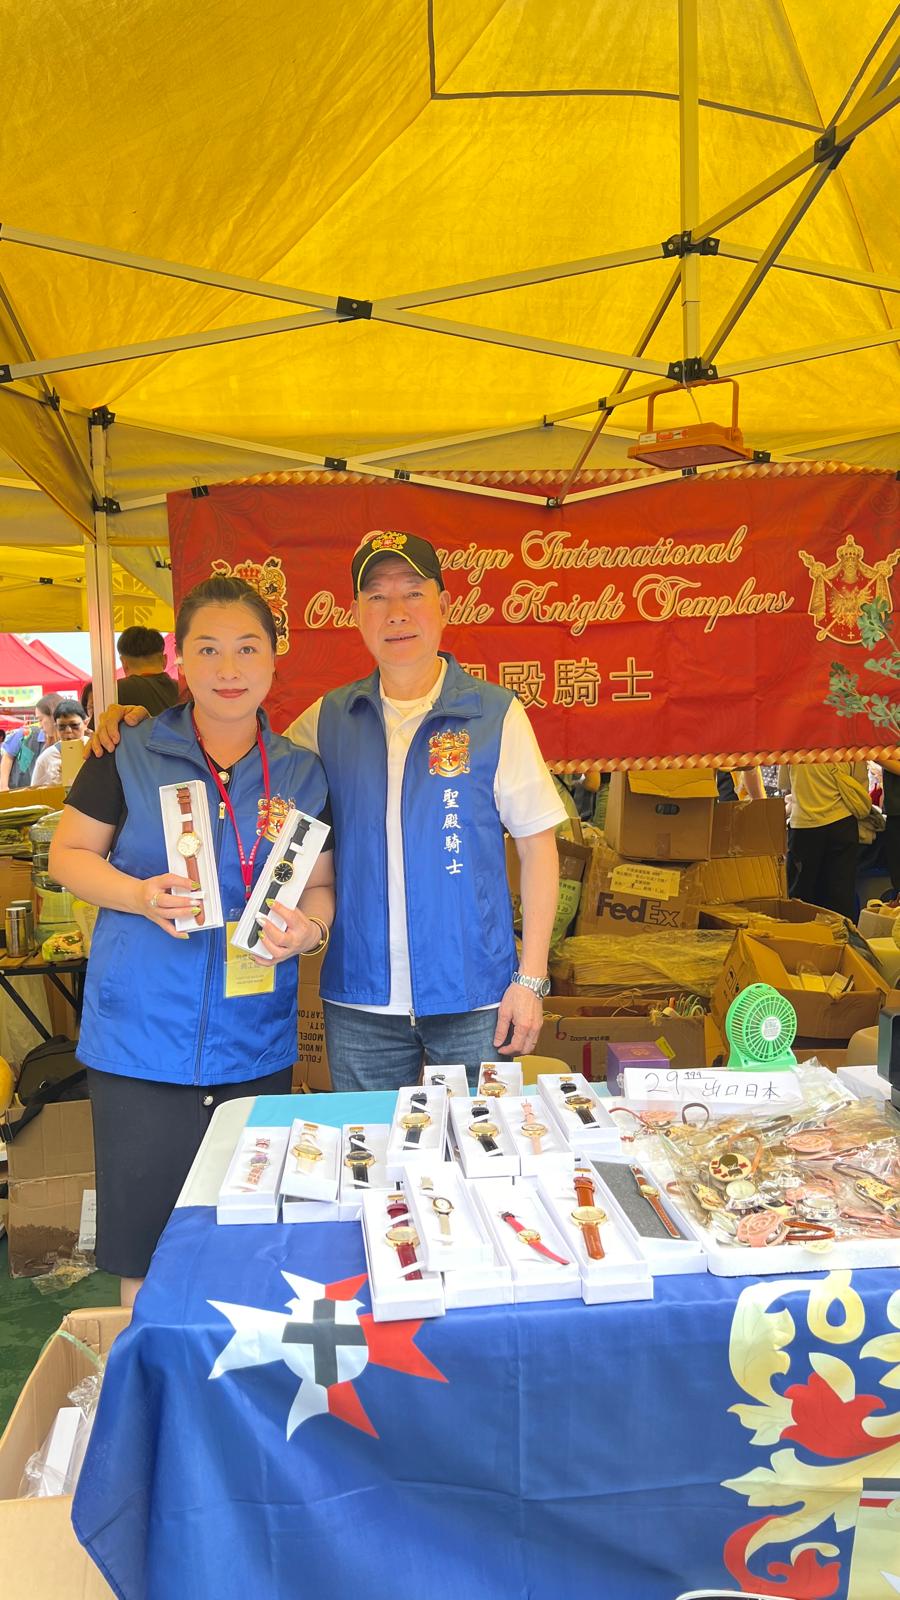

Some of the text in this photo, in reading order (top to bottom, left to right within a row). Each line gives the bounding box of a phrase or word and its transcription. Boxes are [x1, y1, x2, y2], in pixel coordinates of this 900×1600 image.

[521, 524, 748, 570] International
[449, 586, 494, 625] the
[502, 580, 626, 636] Knight
[632, 573, 795, 633] Templars
[441, 788, 464, 875] 聖殿騎士
[596, 891, 680, 928] FedEx
[299, 1054, 322, 1064] FOLLO
[645, 1070, 681, 1096] 29
[702, 1079, 782, 1100] 出口日本
